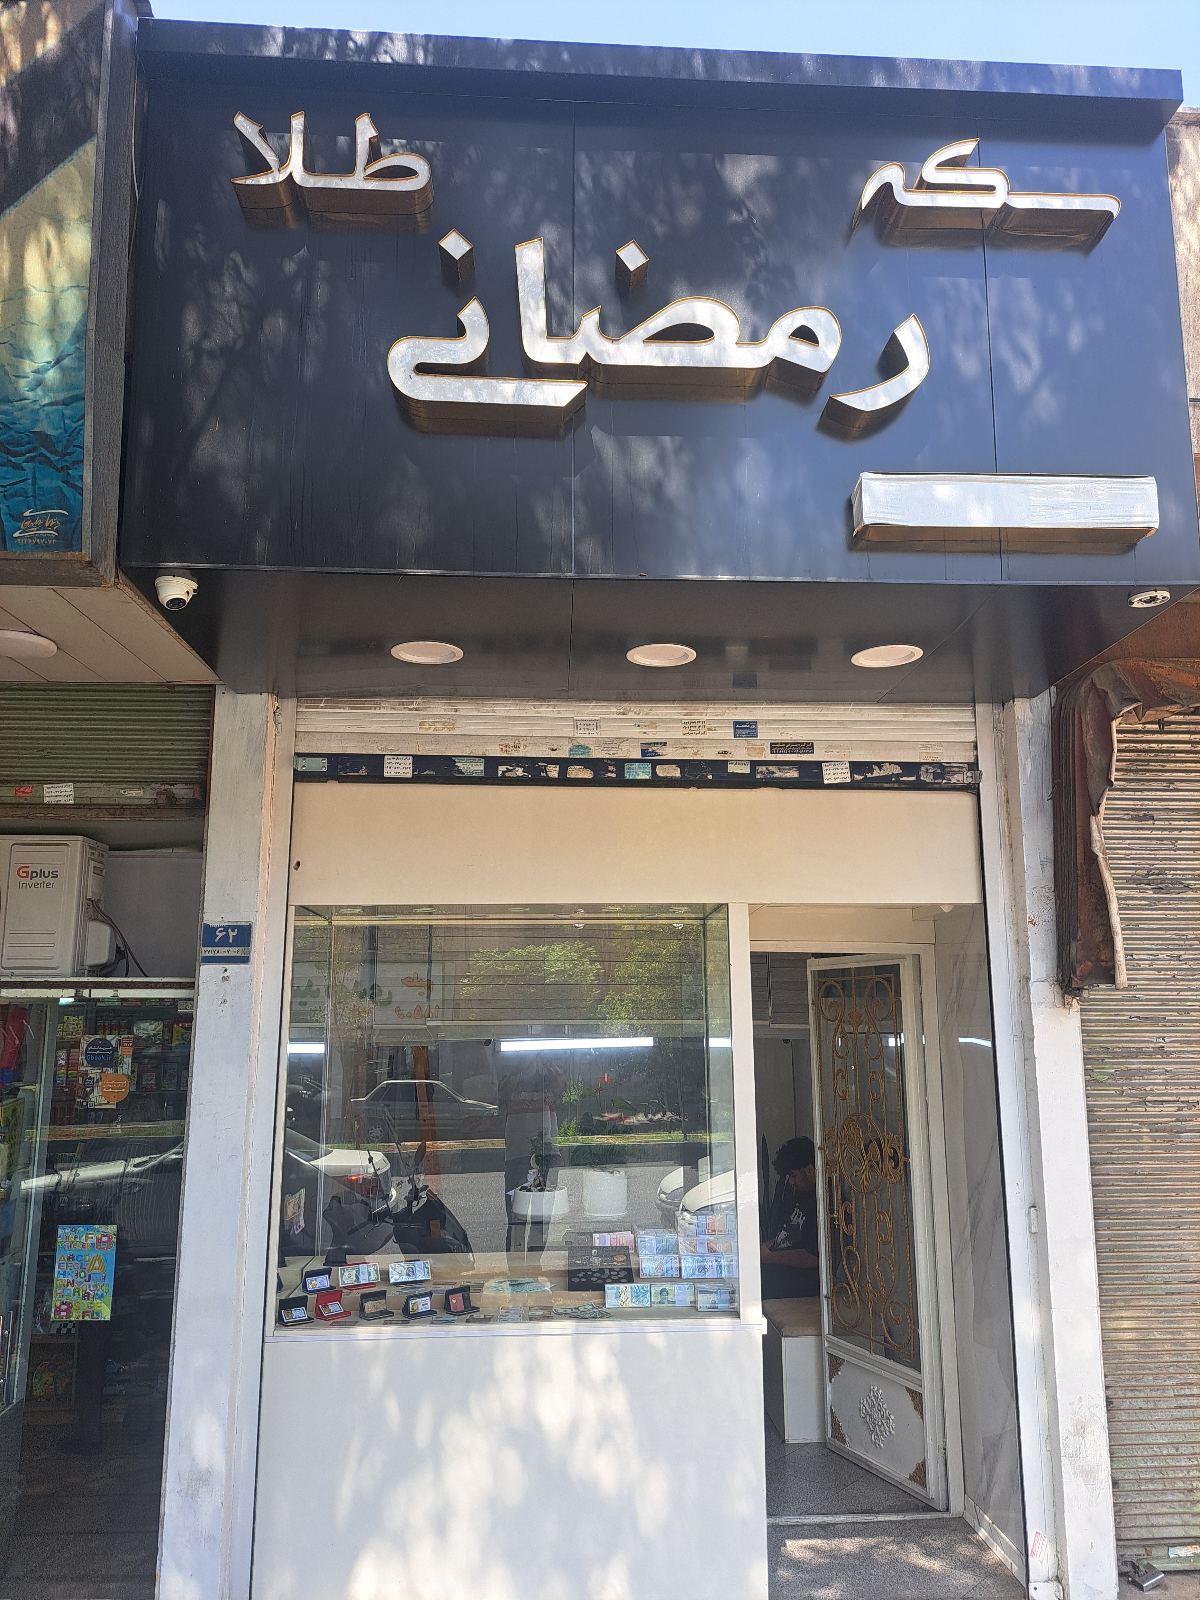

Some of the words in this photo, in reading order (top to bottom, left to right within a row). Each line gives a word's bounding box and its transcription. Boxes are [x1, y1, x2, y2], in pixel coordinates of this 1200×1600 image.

[231, 110, 434, 195] طلا
[387, 228, 931, 413] رمضانی
[16, 865, 59, 880] Gplus
[18, 881, 55, 889] Inverter
[214, 927, 238, 943] ۶۲
